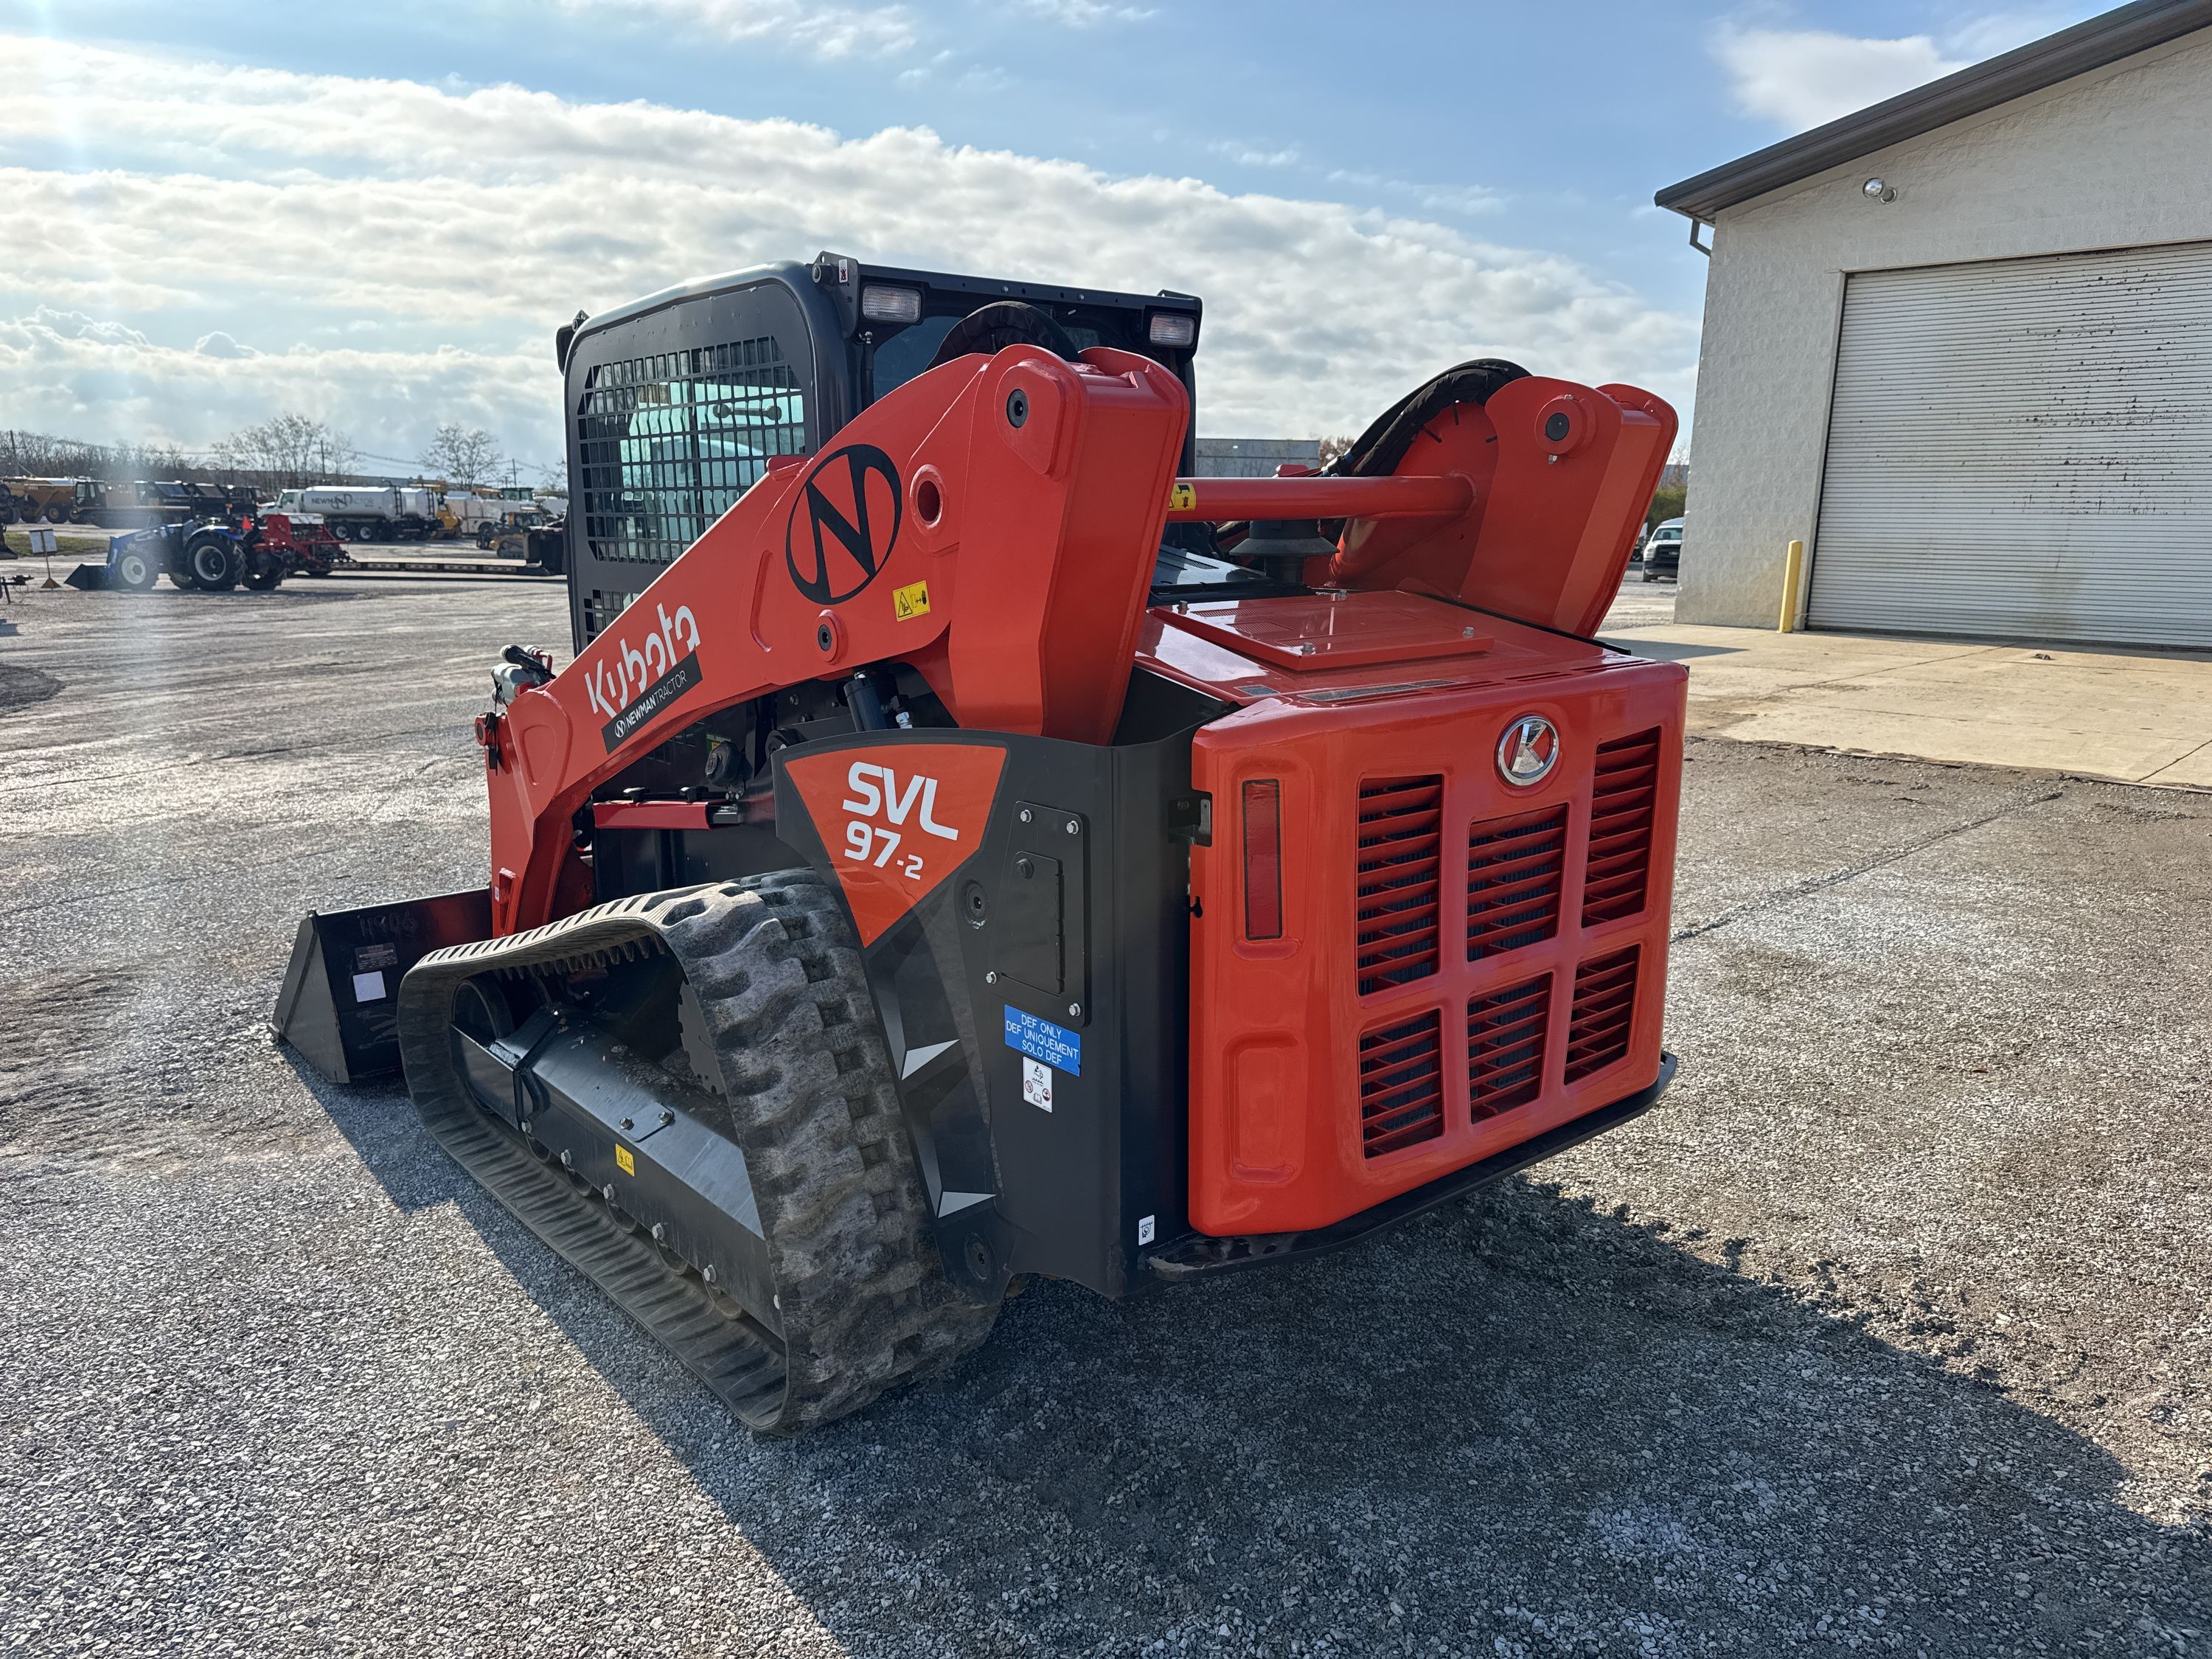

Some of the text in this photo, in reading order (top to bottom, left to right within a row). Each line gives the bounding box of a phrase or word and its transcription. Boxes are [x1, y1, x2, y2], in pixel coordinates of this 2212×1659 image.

[585, 602, 700, 719] Kubota
[843, 762, 959, 841] SVL
[844, 821, 924, 880] 97-2
[1006, 1020, 1079, 1060] DEF UNIQUEMENT
[1021, 1015, 1062, 1040] DEF ONLY
[1022, 1040, 1062, 1065] SOLO DEF
